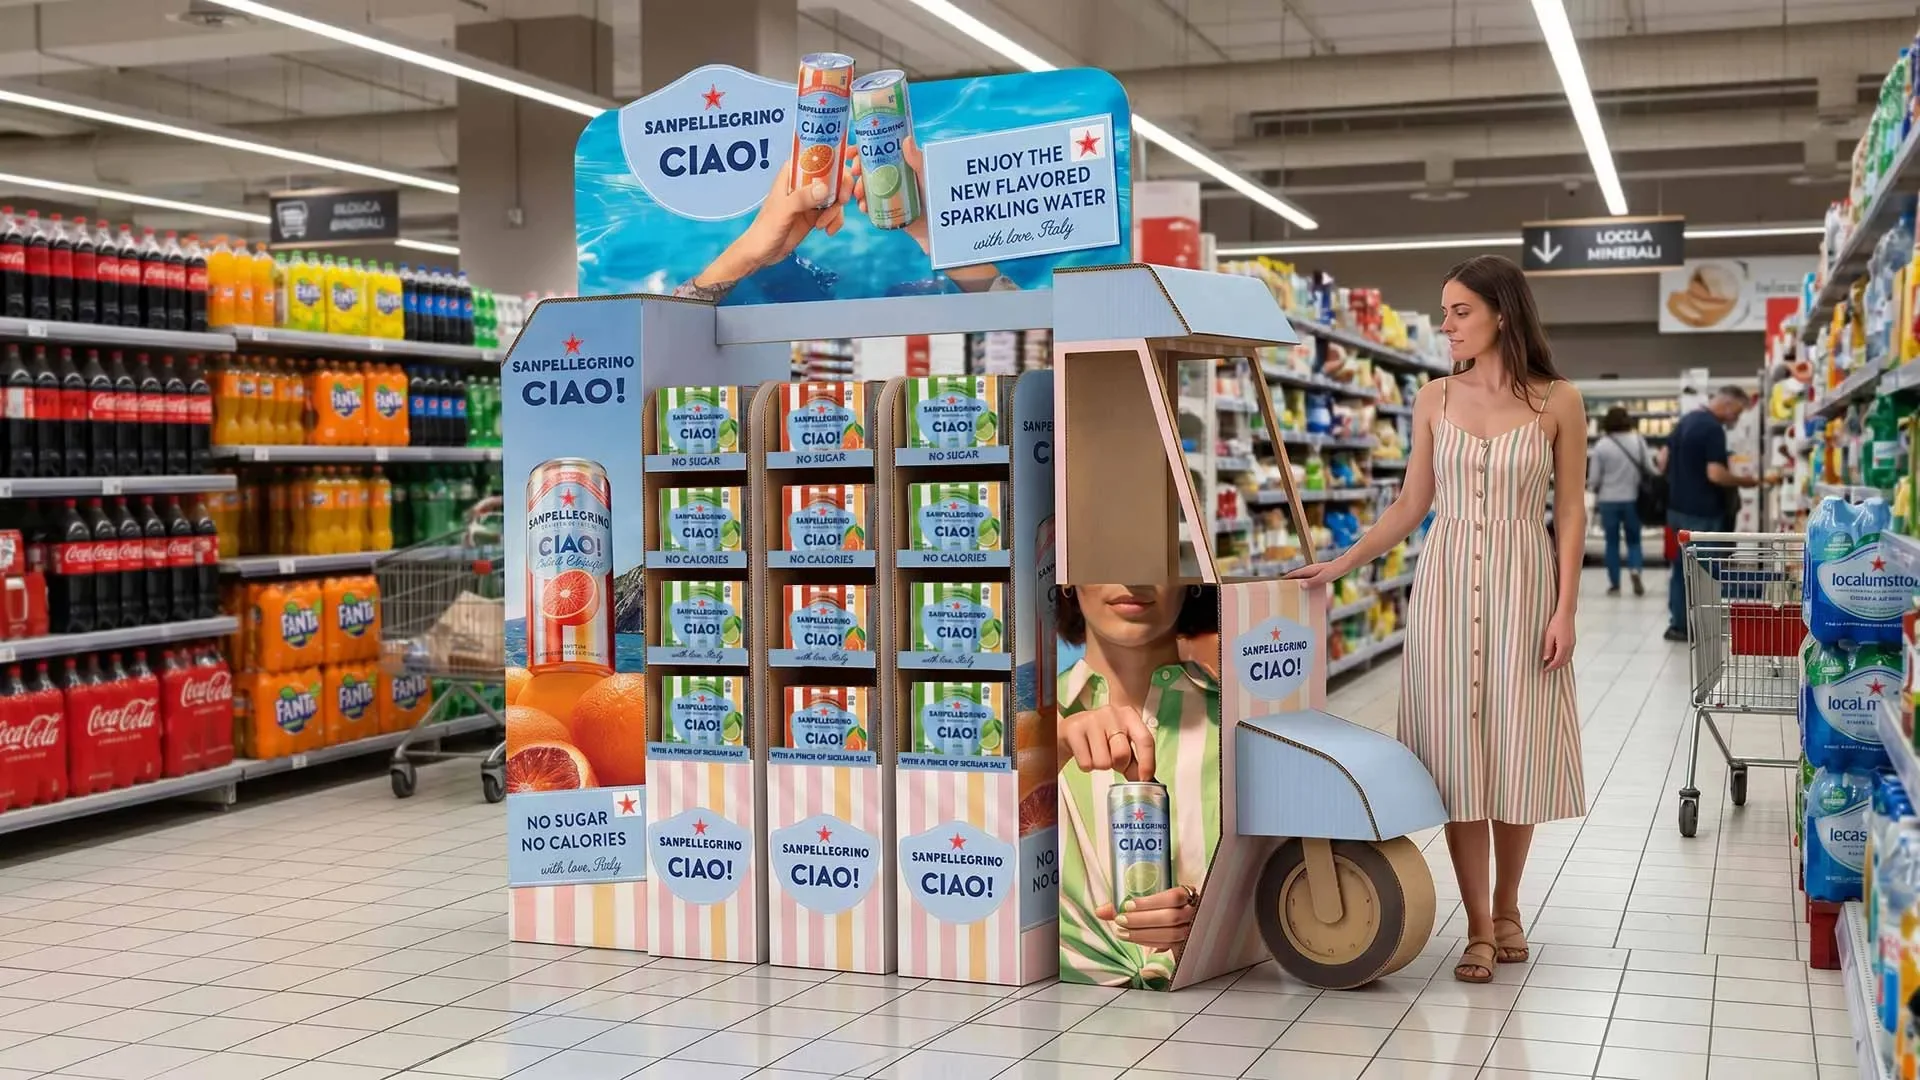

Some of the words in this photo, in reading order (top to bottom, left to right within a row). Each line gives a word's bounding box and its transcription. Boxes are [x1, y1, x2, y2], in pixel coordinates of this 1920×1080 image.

[644, 108, 784, 135] SANPELLEGRINO
[802, 121, 840, 134] CIAO!
[861, 138, 901, 157] CIAO!
[659, 139, 769, 177] CIAO!
[967, 152, 1023, 175] ENJOY
[1028, 146, 1063, 165] THE
[951, 181, 991, 201] NEW
[996, 166, 1090, 195] FLAVORED
[940, 199, 1039, 227] SPARKLING
[1043, 188, 1106, 212] WATER
[973, 231, 1003, 250] with
[512, 356, 634, 372] SANPELLEGRINO
[522, 377, 625, 406] CIAO!
[680, 428, 716, 439] CIAO!
[932, 421, 972, 432] CIAO!
[802, 431, 840, 445] CIAO!
[672, 458, 686, 466] NO
[689, 456, 720, 466] SUGAR
[796, 455, 811, 464] NO
[814, 452, 846, 463] SUGAR
[929, 452, 945, 461] NO
[946, 450, 979, 460] SUGAR
[529, 510, 610, 530] SANPELLEGRINO
[682, 527, 718, 538] CIAO!
[934, 526, 975, 538] CIAO!
[539, 534, 602, 557] CIAO!
[803, 534, 841, 546] CIAO!
[665, 555, 680, 564] NO
[682, 555, 729, 564] CALORIES
[789, 555, 805, 564] NO
[807, 555, 854, 564] CALORIES
[923, 554, 938, 563] NO
[940, 553, 987, 563] CALORIES
[684, 623, 720, 635] CIAO!
[936, 627, 977, 639] CIAO!
[804, 633, 842, 646] CIAO!
[1242, 640, 1307, 657] SANPELLEGRINO
[1250, 657, 1302, 682] CIAO!
[684, 719, 720, 731] CIAO!
[805, 732, 843, 746] CIAO!
[937, 727, 978, 740] CIAO!
[527, 815, 551, 830] NO
[555, 811, 608, 828] SUGAR
[1112, 822, 1168, 830] SANPELLEGRINO
[521, 837, 546, 852] NO
[550, 831, 627, 850] CALORIES
[659, 836, 742, 850] SANPELLEGRINO
[1119, 838, 1162, 851] CIAO!
[782, 843, 870, 858] SANPELLEGRINO
[912, 851, 1003, 867] SANPELLEGRINO
[1036, 850, 1055, 869] NO
[541, 859, 565, 876] with
[668, 856, 733, 880] CIAO!
[791, 864, 860, 888] CIAO!
[1033, 873, 1049, 893] NO
[921, 872, 993, 898] CIAO!
